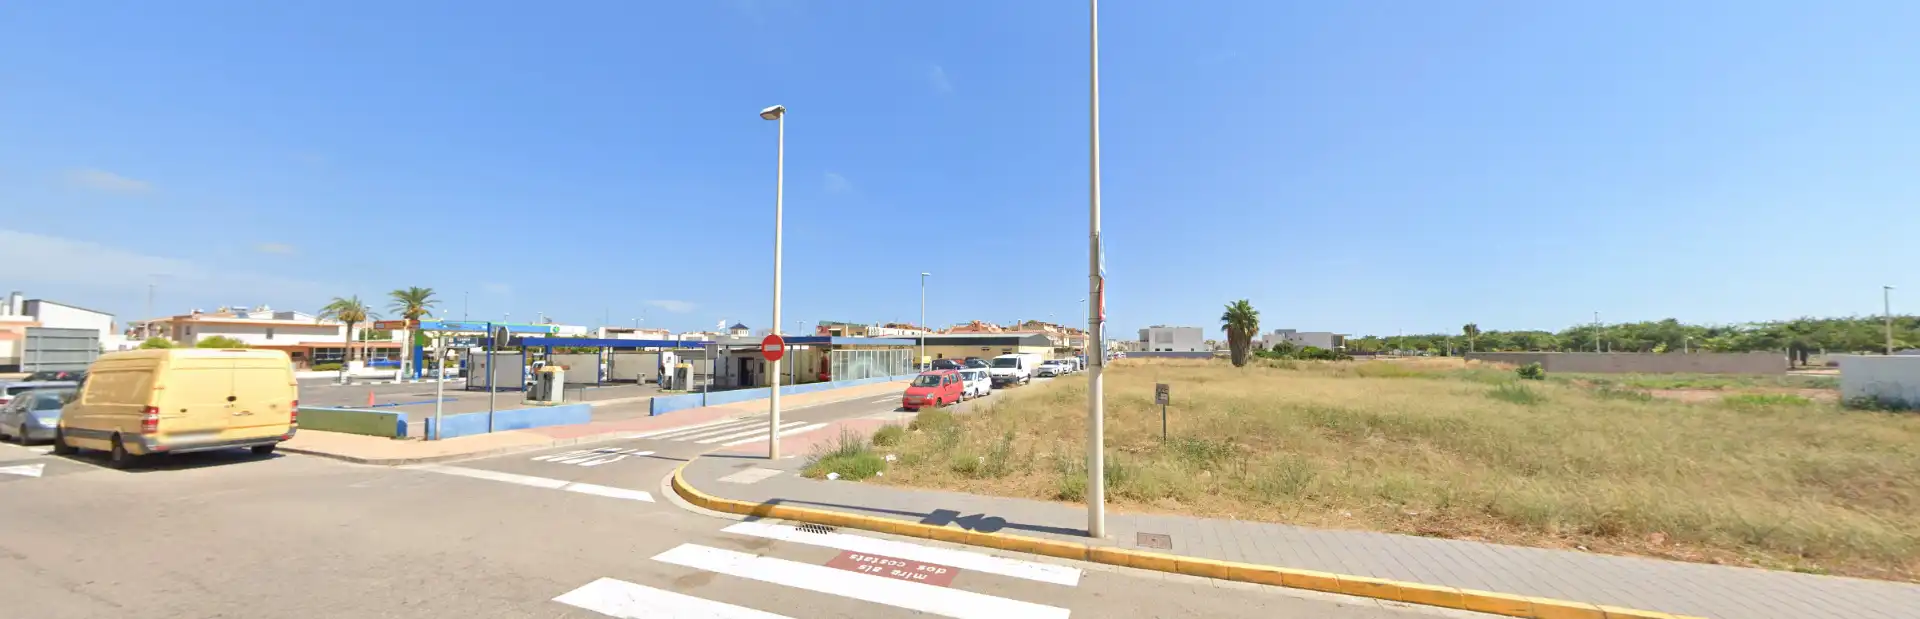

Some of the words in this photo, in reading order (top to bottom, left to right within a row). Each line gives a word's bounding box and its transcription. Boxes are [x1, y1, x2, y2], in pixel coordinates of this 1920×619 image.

[848, 553, 906, 568] costats
[857, 563, 883, 573] als
[916, 564, 947, 575] dos
